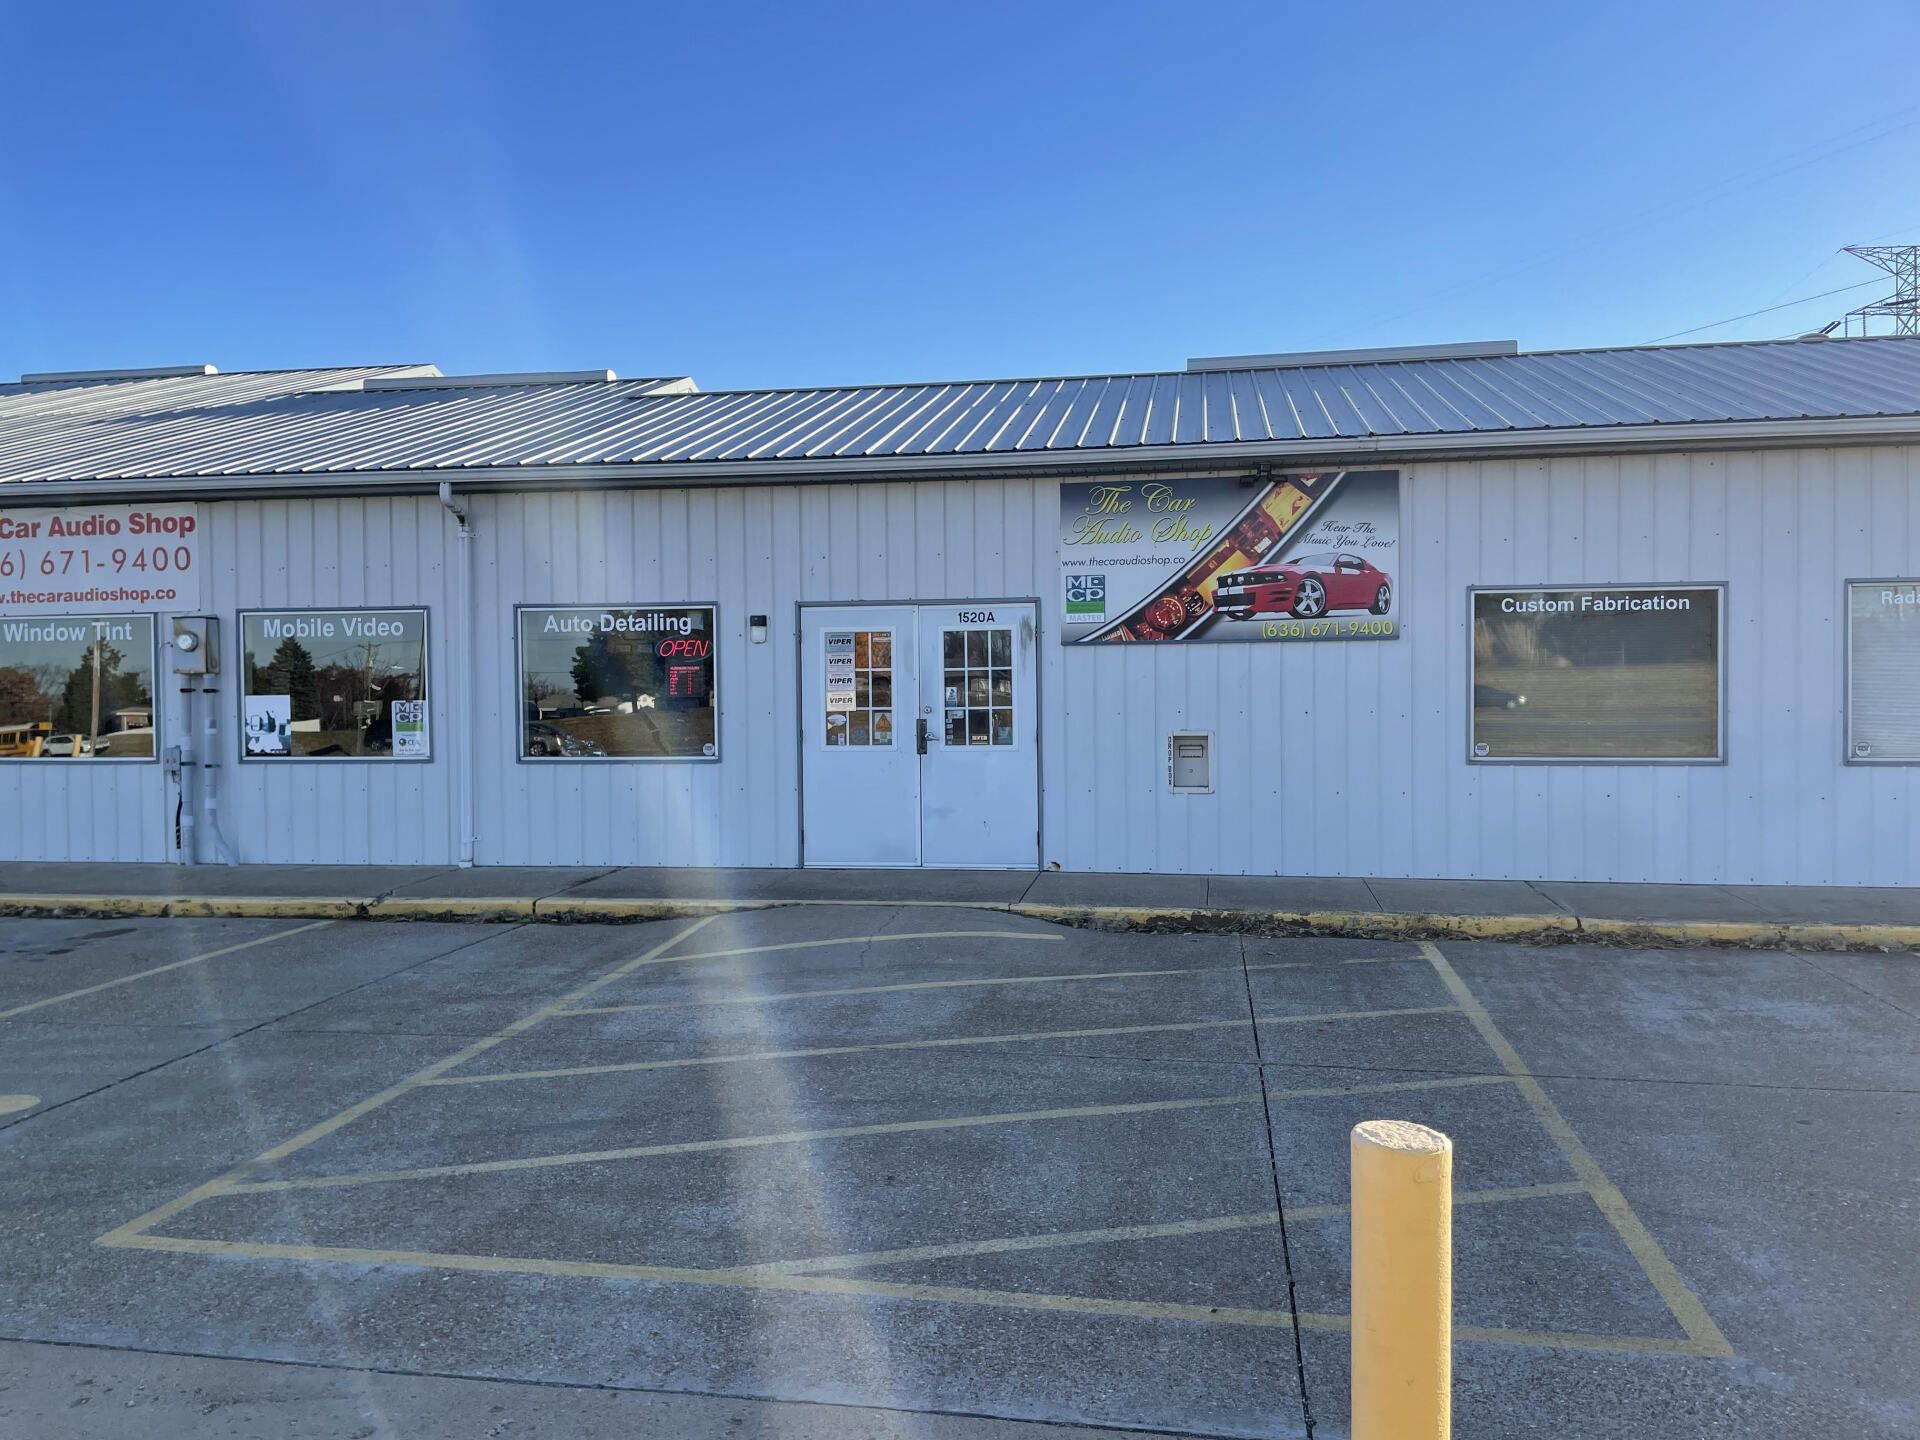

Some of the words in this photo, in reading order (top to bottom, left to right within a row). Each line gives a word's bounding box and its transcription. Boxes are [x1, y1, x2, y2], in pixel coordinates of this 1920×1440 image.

[1085, 486, 1132, 516] The
[1141, 482, 1196, 513] Car
[0, 517, 41, 539] Car
[48, 514, 120, 537] Audio
[129, 512, 196, 538] Shop
[1063, 515, 1143, 545] Audio
[1151, 513, 1213, 551] Shop
[1320, 520, 1350, 532] Hear
[1352, 522, 1376, 534] The
[1297, 533, 1331, 545] Music
[1332, 535, 1358, 549] You
[1360, 536, 1396, 548] Love!
[40, 546, 191, 575] 671-9400
[1062, 555, 1185, 567] www.thecaraudioshop.co
[1501, 597, 1575, 613] Custom
[1581, 595, 1690, 612] Fabrication
[543, 614, 593, 633] Auto
[600, 613, 692, 635] Detailing
[958, 611, 995, 623] 1520A
[4, 622, 86, 642] Window
[91, 621, 133, 641] Tint
[263, 618, 335, 638] Mobile
[341, 617, 404, 637] Video
[1262, 620, 1306, 638] (636)
[1310, 620, 1393, 636] 671-9400
[660, 639, 709, 657] OPEN
